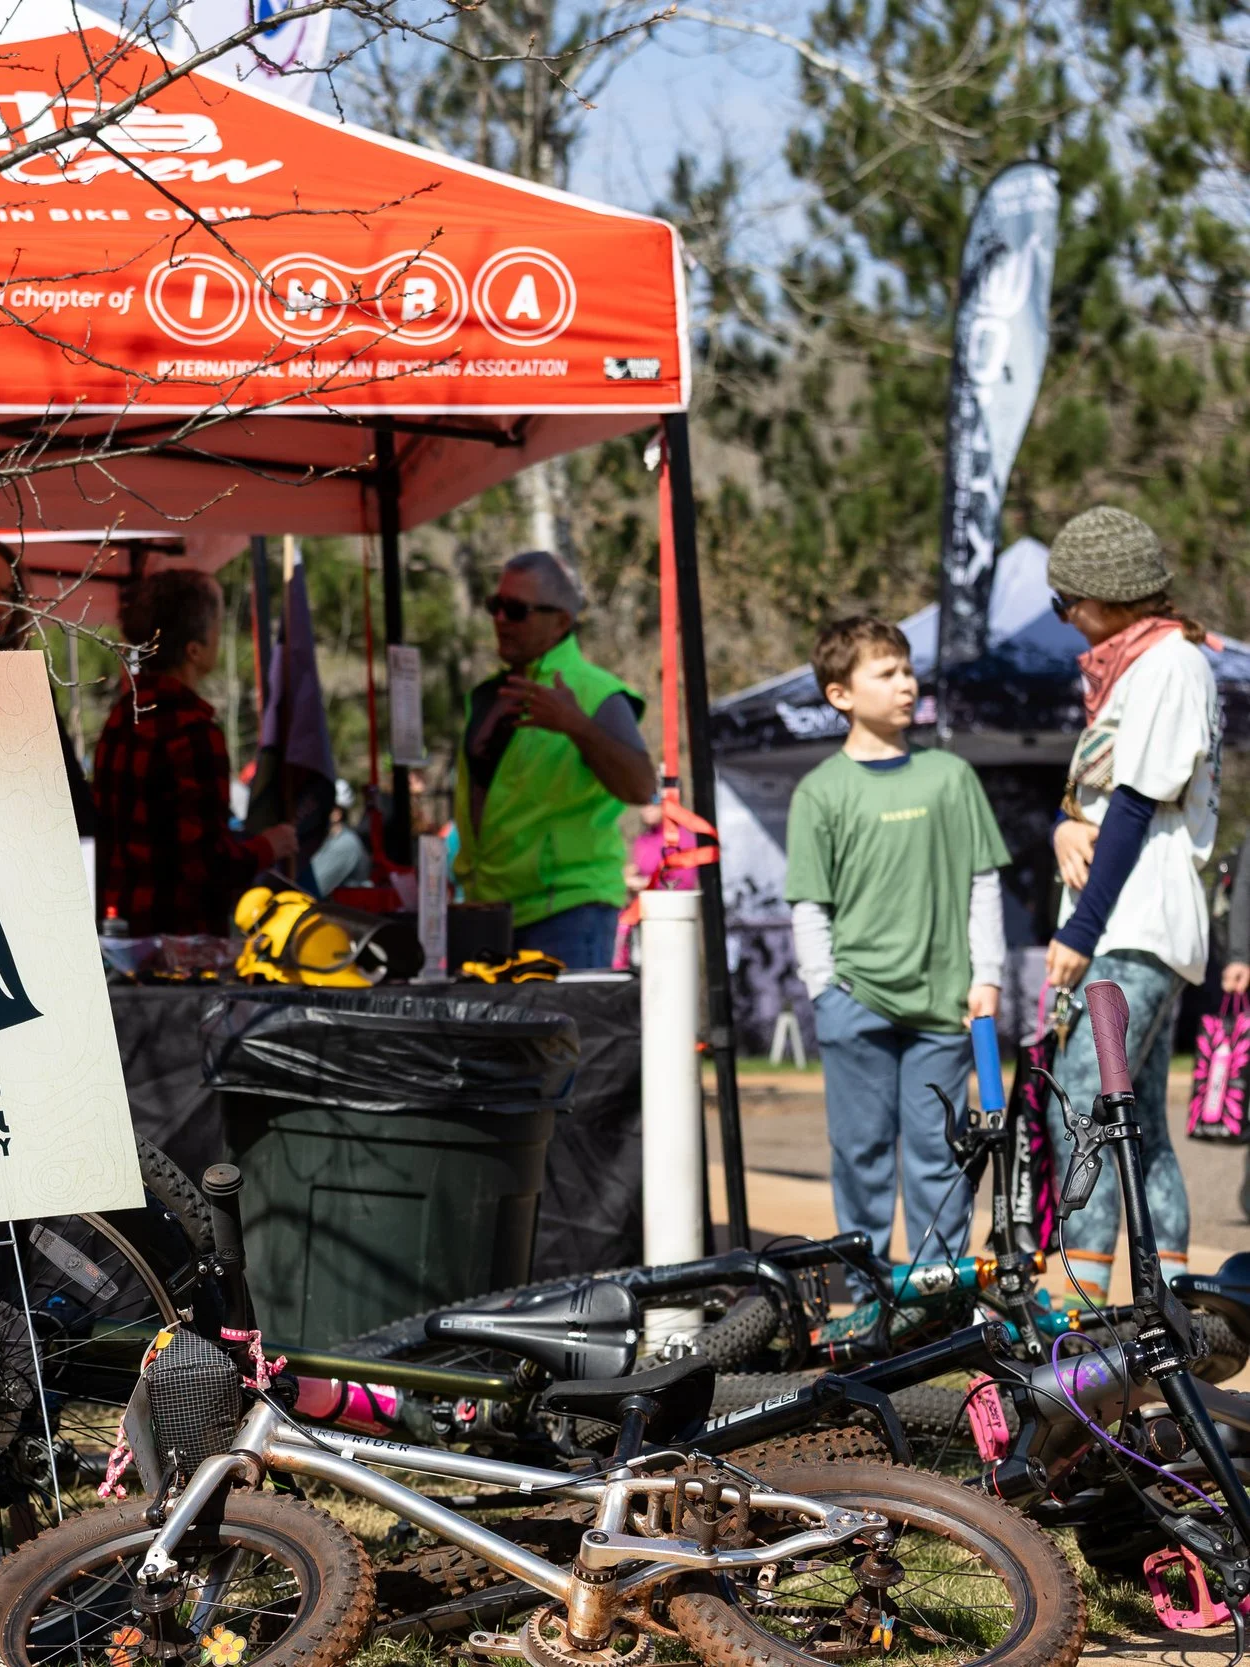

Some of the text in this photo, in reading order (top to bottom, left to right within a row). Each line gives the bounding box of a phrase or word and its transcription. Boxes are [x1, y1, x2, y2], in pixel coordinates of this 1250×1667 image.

[49, 208, 130, 221] BIKE
[10, 285, 105, 314] chapter
[108, 285, 136, 315] of
[463, 359, 569, 378] ASSOCIATION
